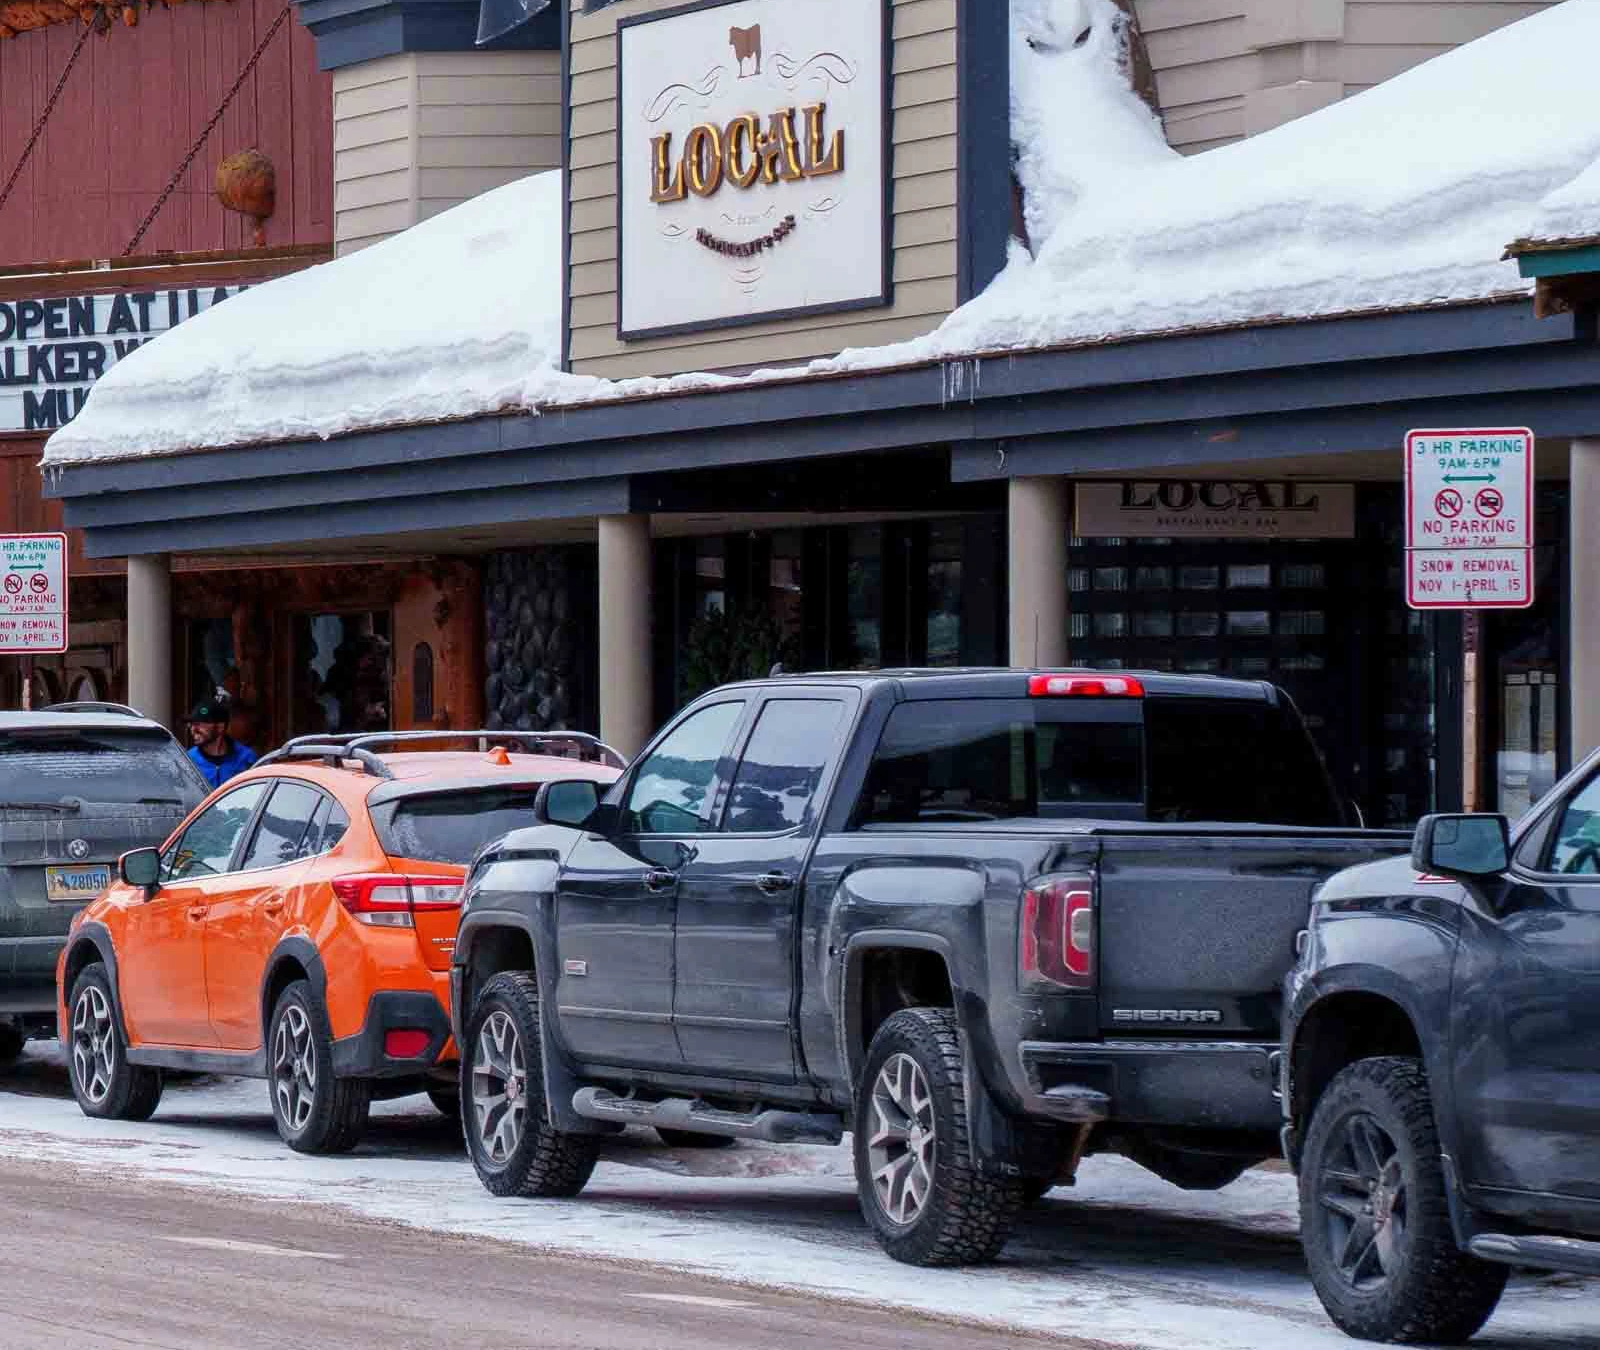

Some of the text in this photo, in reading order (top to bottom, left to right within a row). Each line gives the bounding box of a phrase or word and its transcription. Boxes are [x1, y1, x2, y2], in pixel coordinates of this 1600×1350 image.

[649, 101, 845, 205] LOCAL
[107, 291, 157, 334] AT
[1416, 439, 1523, 454] 3 HR PARKING
[1439, 458, 1501, 469] 9AM-6PM
[1423, 519, 1516, 533] NO PARKING
[3, 541, 17, 551] HR
[20, 540, 60, 551] PARKING
[1421, 560, 1520, 572] SNOW REMOVAL
[1419, 579, 1443, 592] NOV
[1508, 578, 1521, 591] 15
[15, 594, 57, 604] PARKING
[22, 620, 57, 629] REMOVAL
[51, 633, 60, 642] 15
[1112, 1009, 1221, 1022] SIERRA
